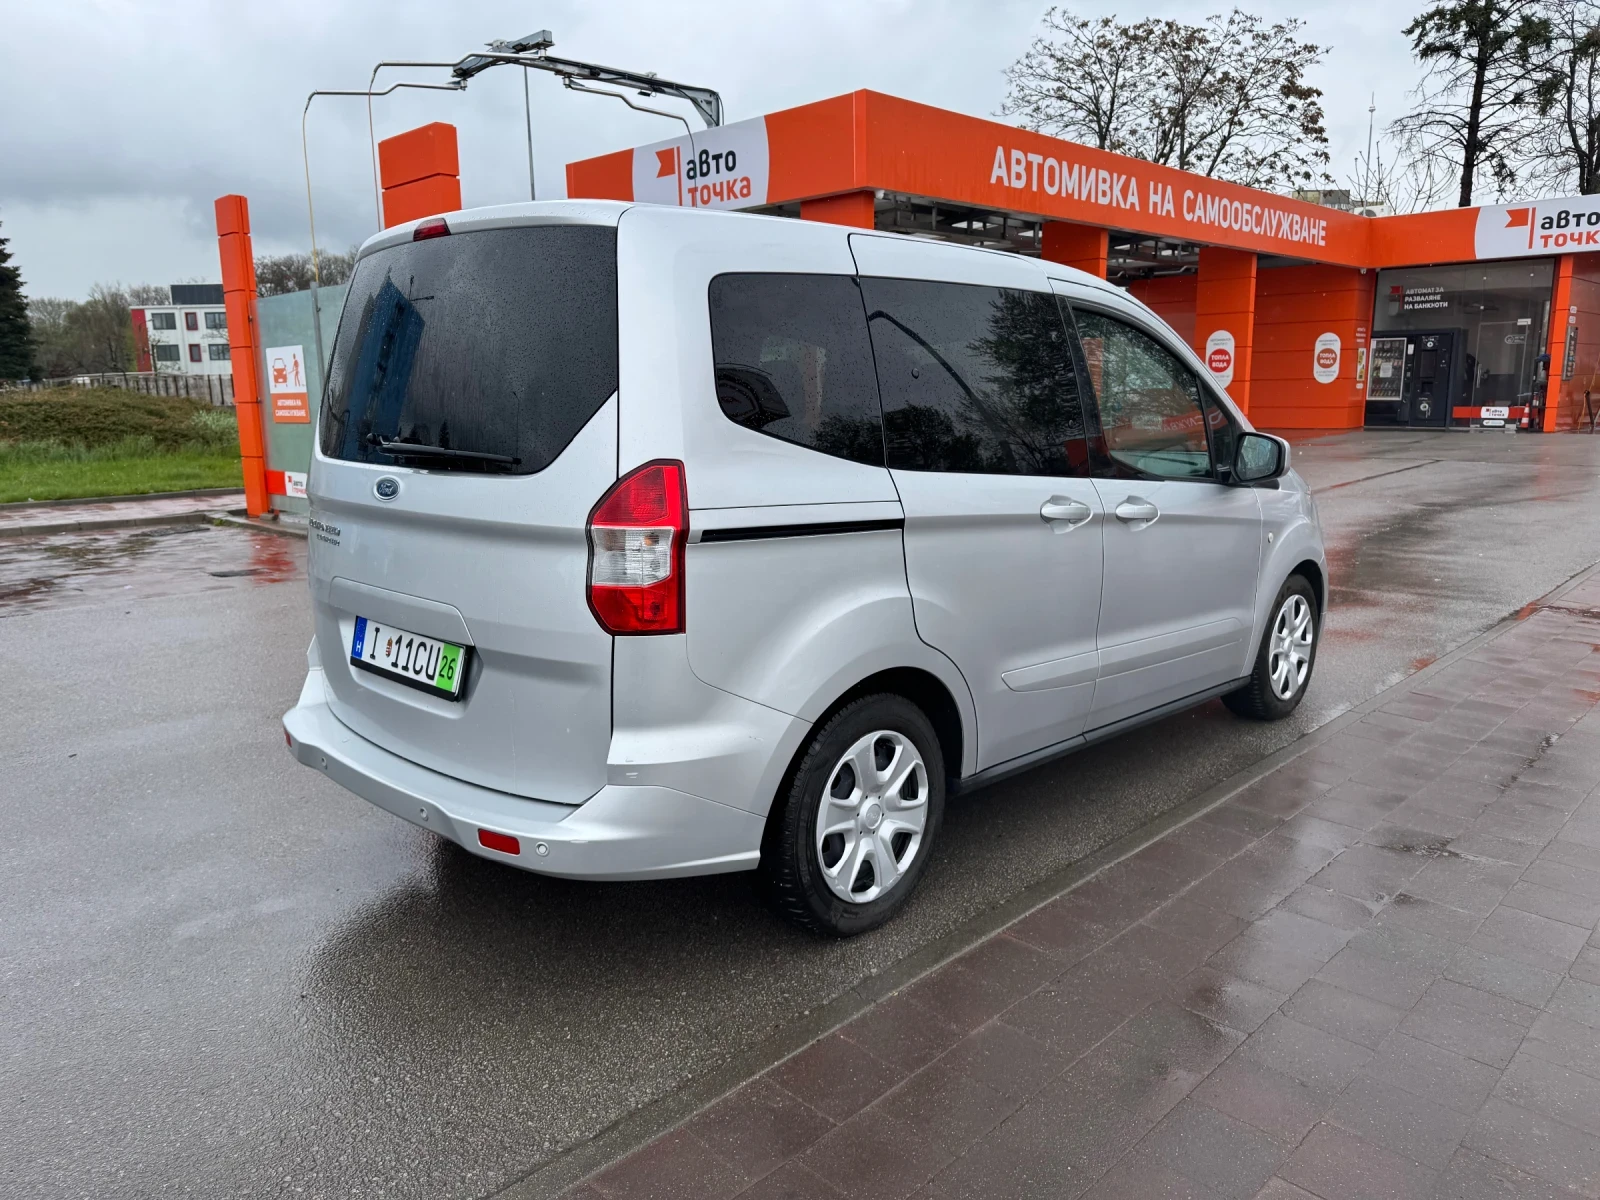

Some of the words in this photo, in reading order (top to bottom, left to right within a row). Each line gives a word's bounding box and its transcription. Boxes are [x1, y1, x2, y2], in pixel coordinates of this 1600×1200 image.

[686, 148, 737, 180] авто
[687, 176, 751, 208] точка
[990, 145, 1140, 212] АВТОМИВКА
[1149, 180, 1175, 218] НА
[1182, 189, 1327, 247] САМООБСЛУЖВАНЕ
[1540, 209, 1600, 230] авто
[1540, 229, 1600, 249] точк
[1404, 294, 1441, 302] РАЗВАЛЯНЕ
[1405, 287, 1434, 295] АВТОМАТ
[1414, 301, 1448, 309] БАНКНОТИ
[391, 634, 442, 681] 11CU
[438, 655, 455, 681] 26
